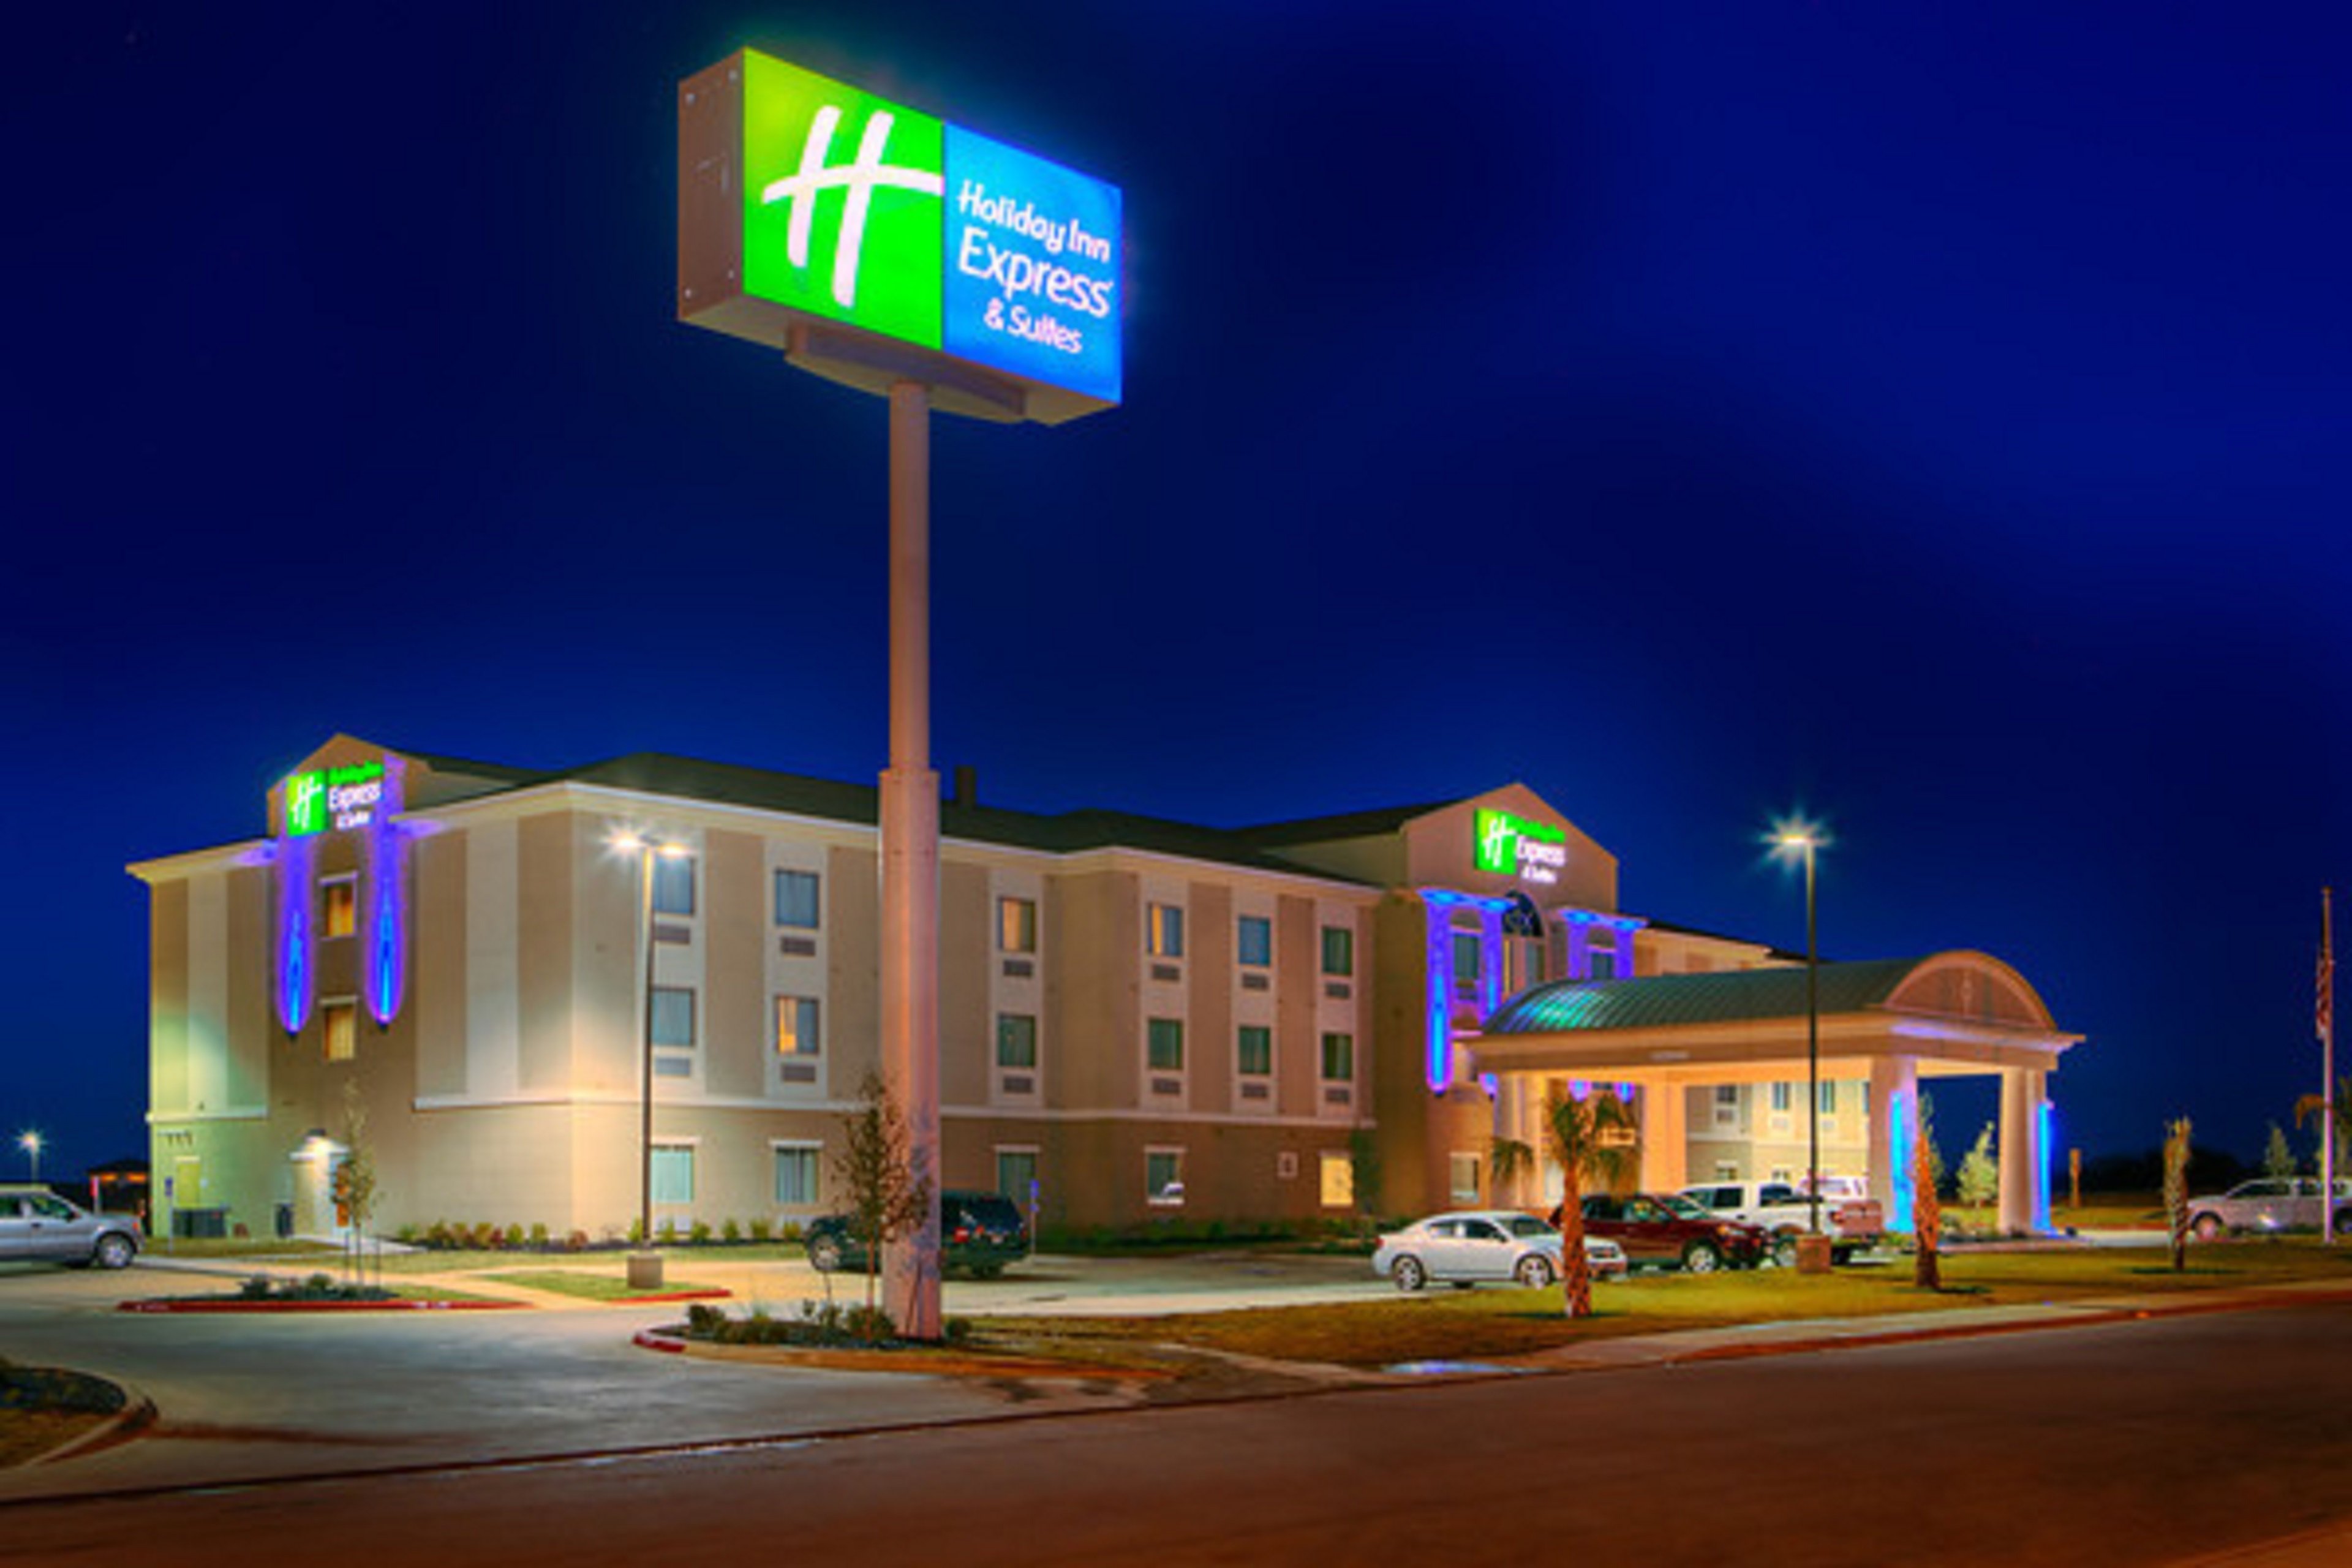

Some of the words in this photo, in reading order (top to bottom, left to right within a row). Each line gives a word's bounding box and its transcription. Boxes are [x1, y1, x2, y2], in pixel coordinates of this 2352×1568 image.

[957, 179, 1066, 253] Holiday
[1068, 219, 1110, 263] Inn
[959, 224, 1114, 318] Express
[983, 297, 1004, 330] &
[1008, 305, 1082, 353] Suites
